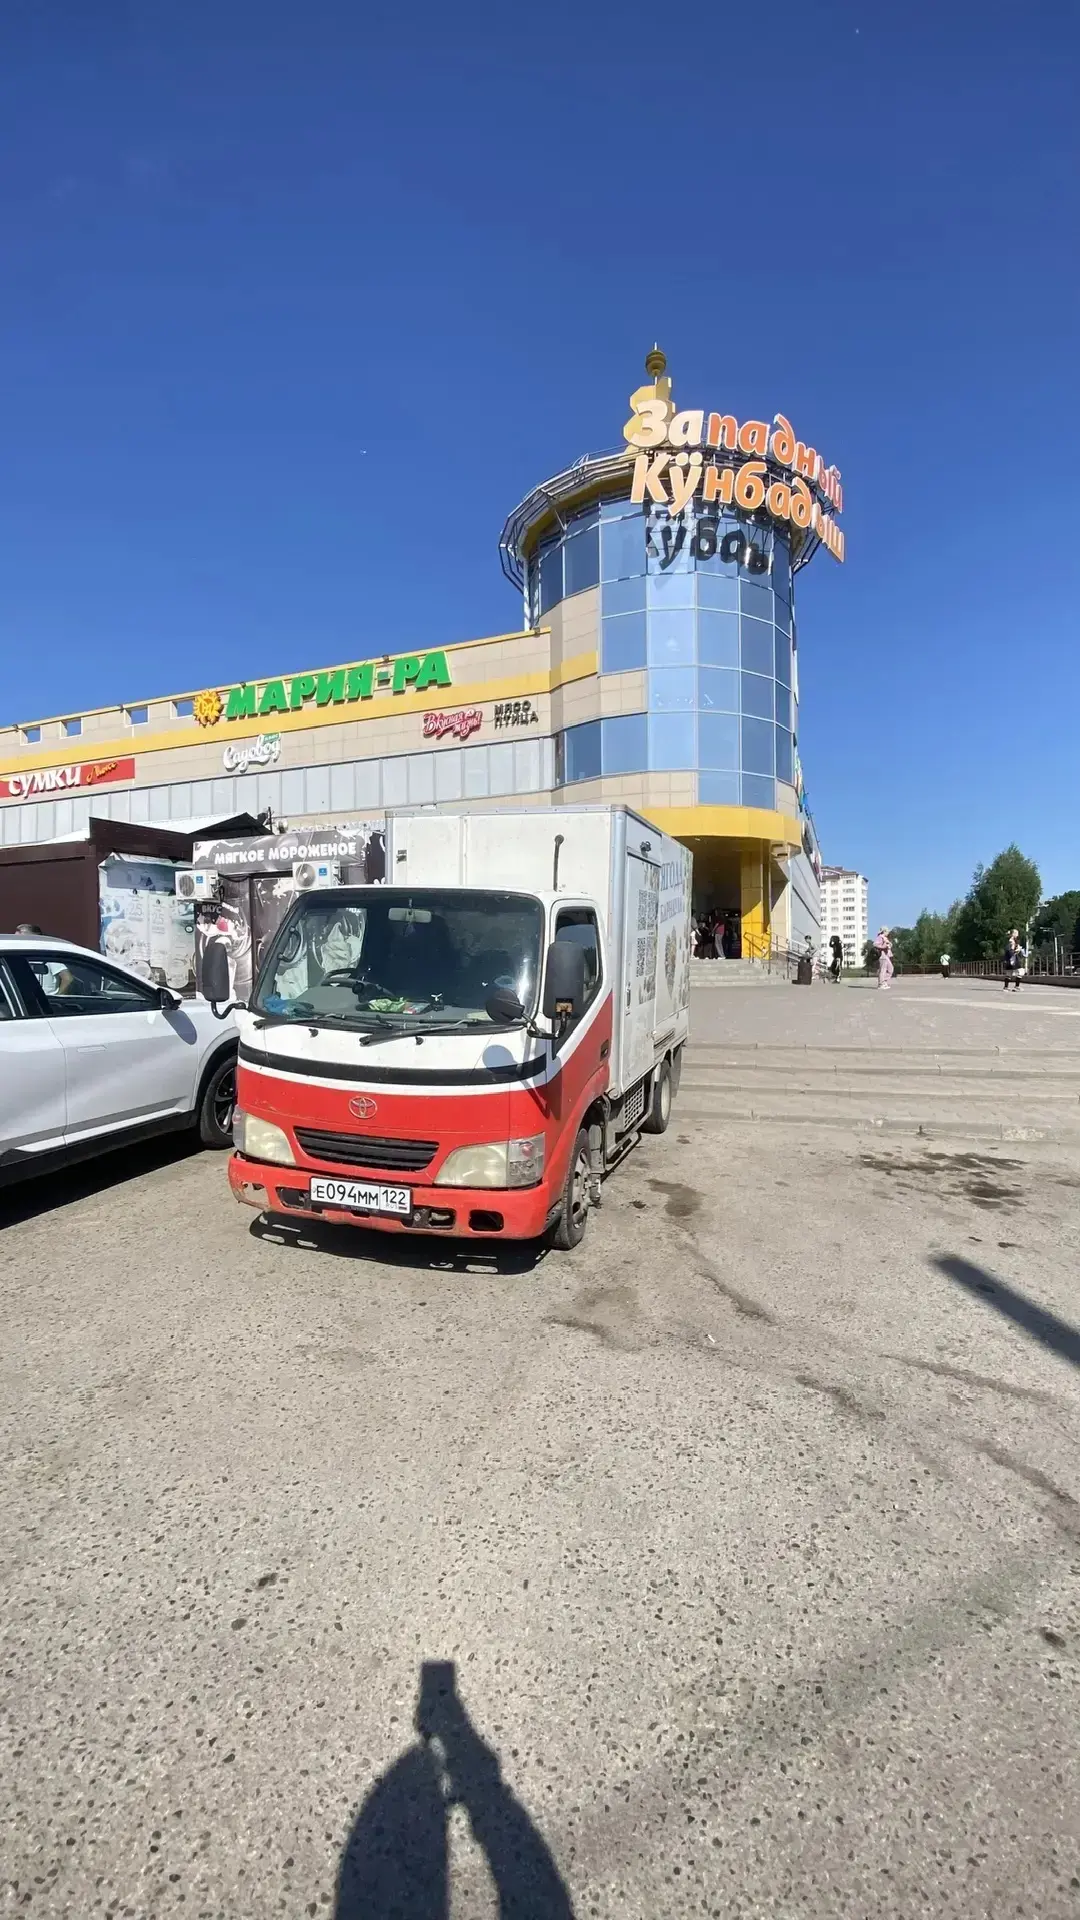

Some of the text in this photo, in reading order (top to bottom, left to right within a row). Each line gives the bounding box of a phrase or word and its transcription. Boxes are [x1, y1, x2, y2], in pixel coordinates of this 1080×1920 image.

[626, 398, 842, 513] Западный
[226, 651, 452, 720] МАРИЯ-РА
[495, 700, 532, 716] МЯСО
[495, 710, 539, 730] ПТИЦА
[423, 710, 464, 736] Вкусная
[214, 841, 357, 865] МЯГКОЕ МОРОЖЕНОЕ
